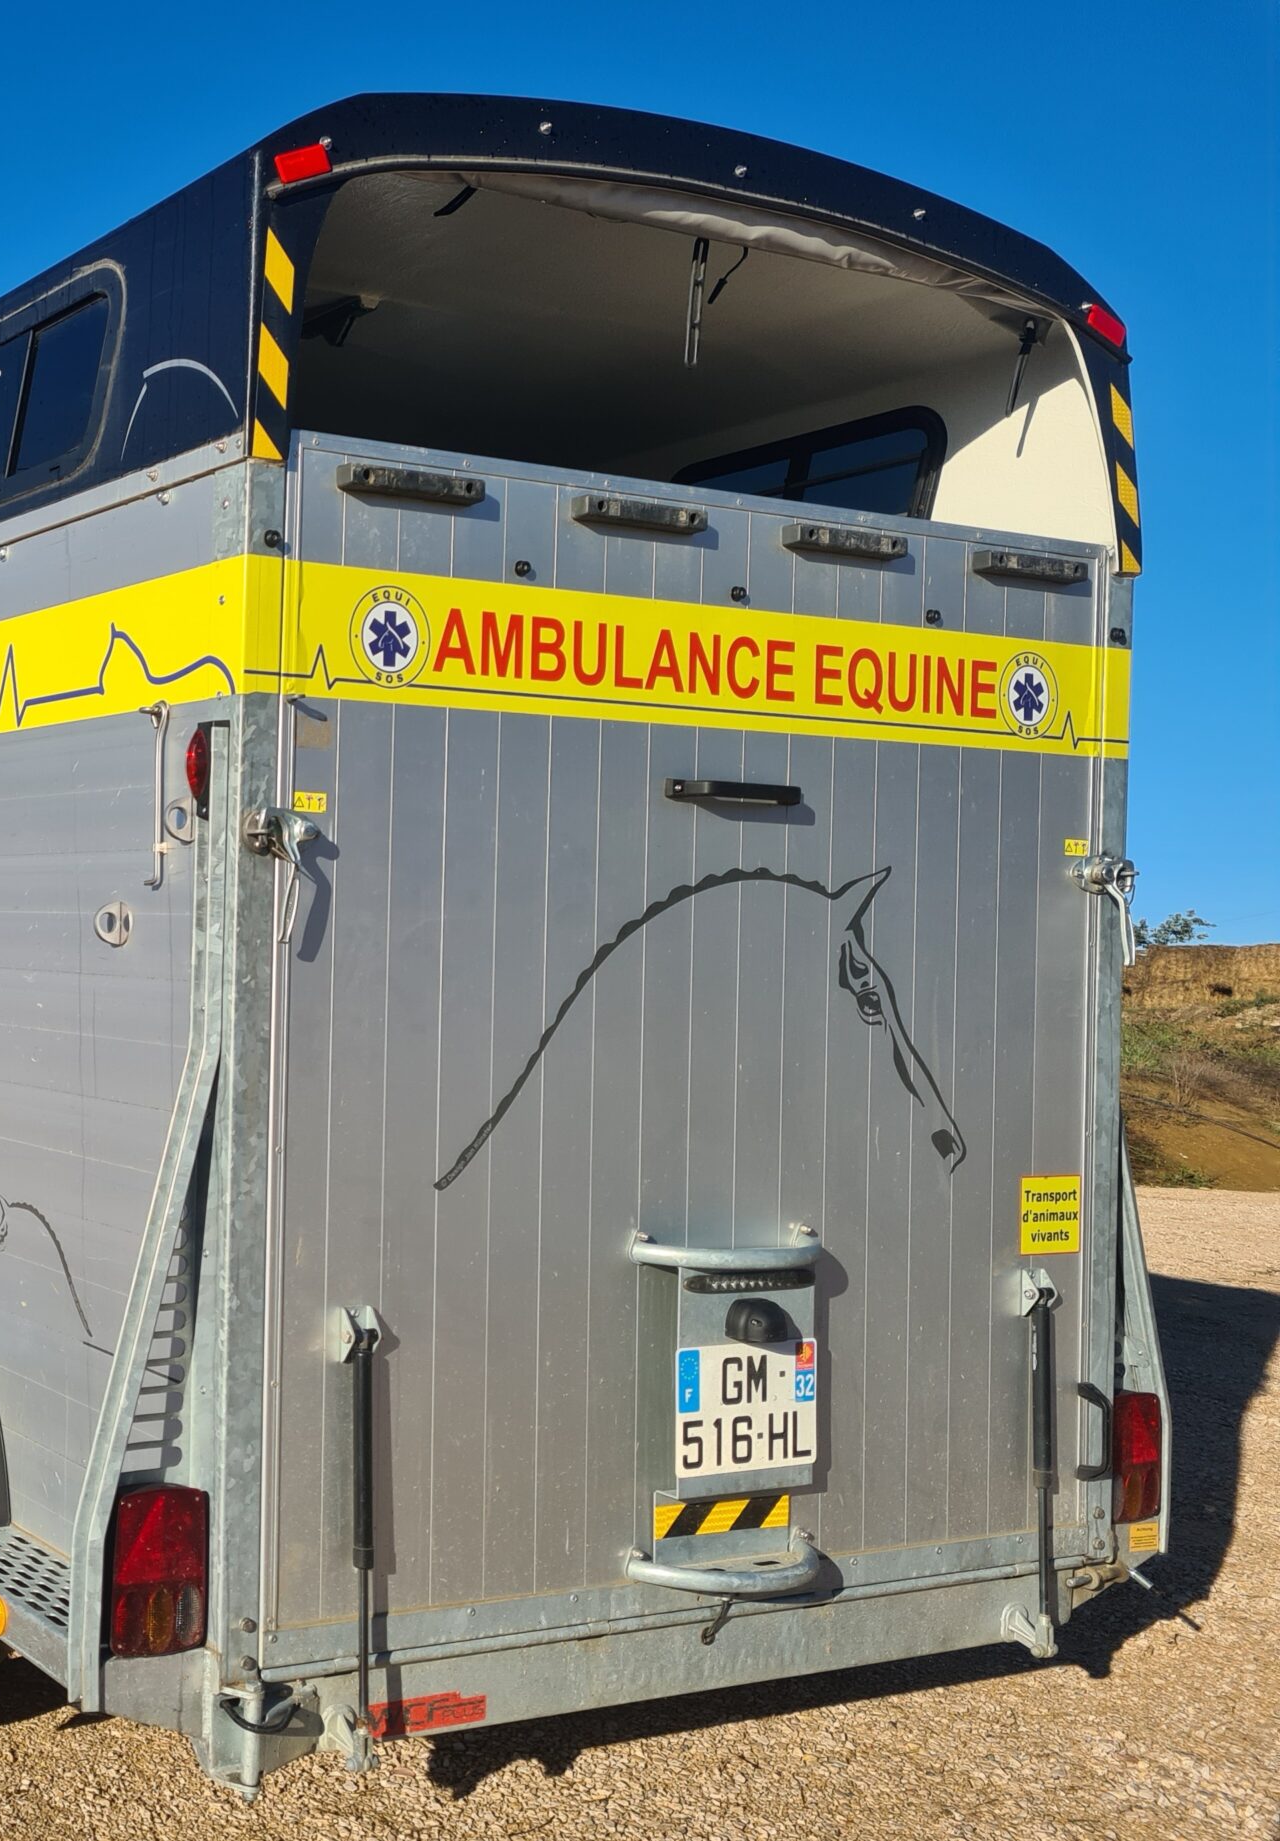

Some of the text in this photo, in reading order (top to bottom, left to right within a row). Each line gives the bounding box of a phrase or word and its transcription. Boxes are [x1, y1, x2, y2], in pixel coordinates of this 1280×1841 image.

[371, 590, 411, 607] EQUI
[432, 607, 998, 720] AMBULANCE EQUINE
[1015, 655, 1045, 670] EQUI
[374, 671, 404, 684] SOS
[1017, 725, 1039, 736] SOS
[1024, 1189, 1077, 1204] Transport
[1022, 1209, 1079, 1223] d'animaux
[1031, 1229, 1070, 1242] vivants
[795, 1373, 815, 1398] 32
[684, 1388, 693, 1403] F
